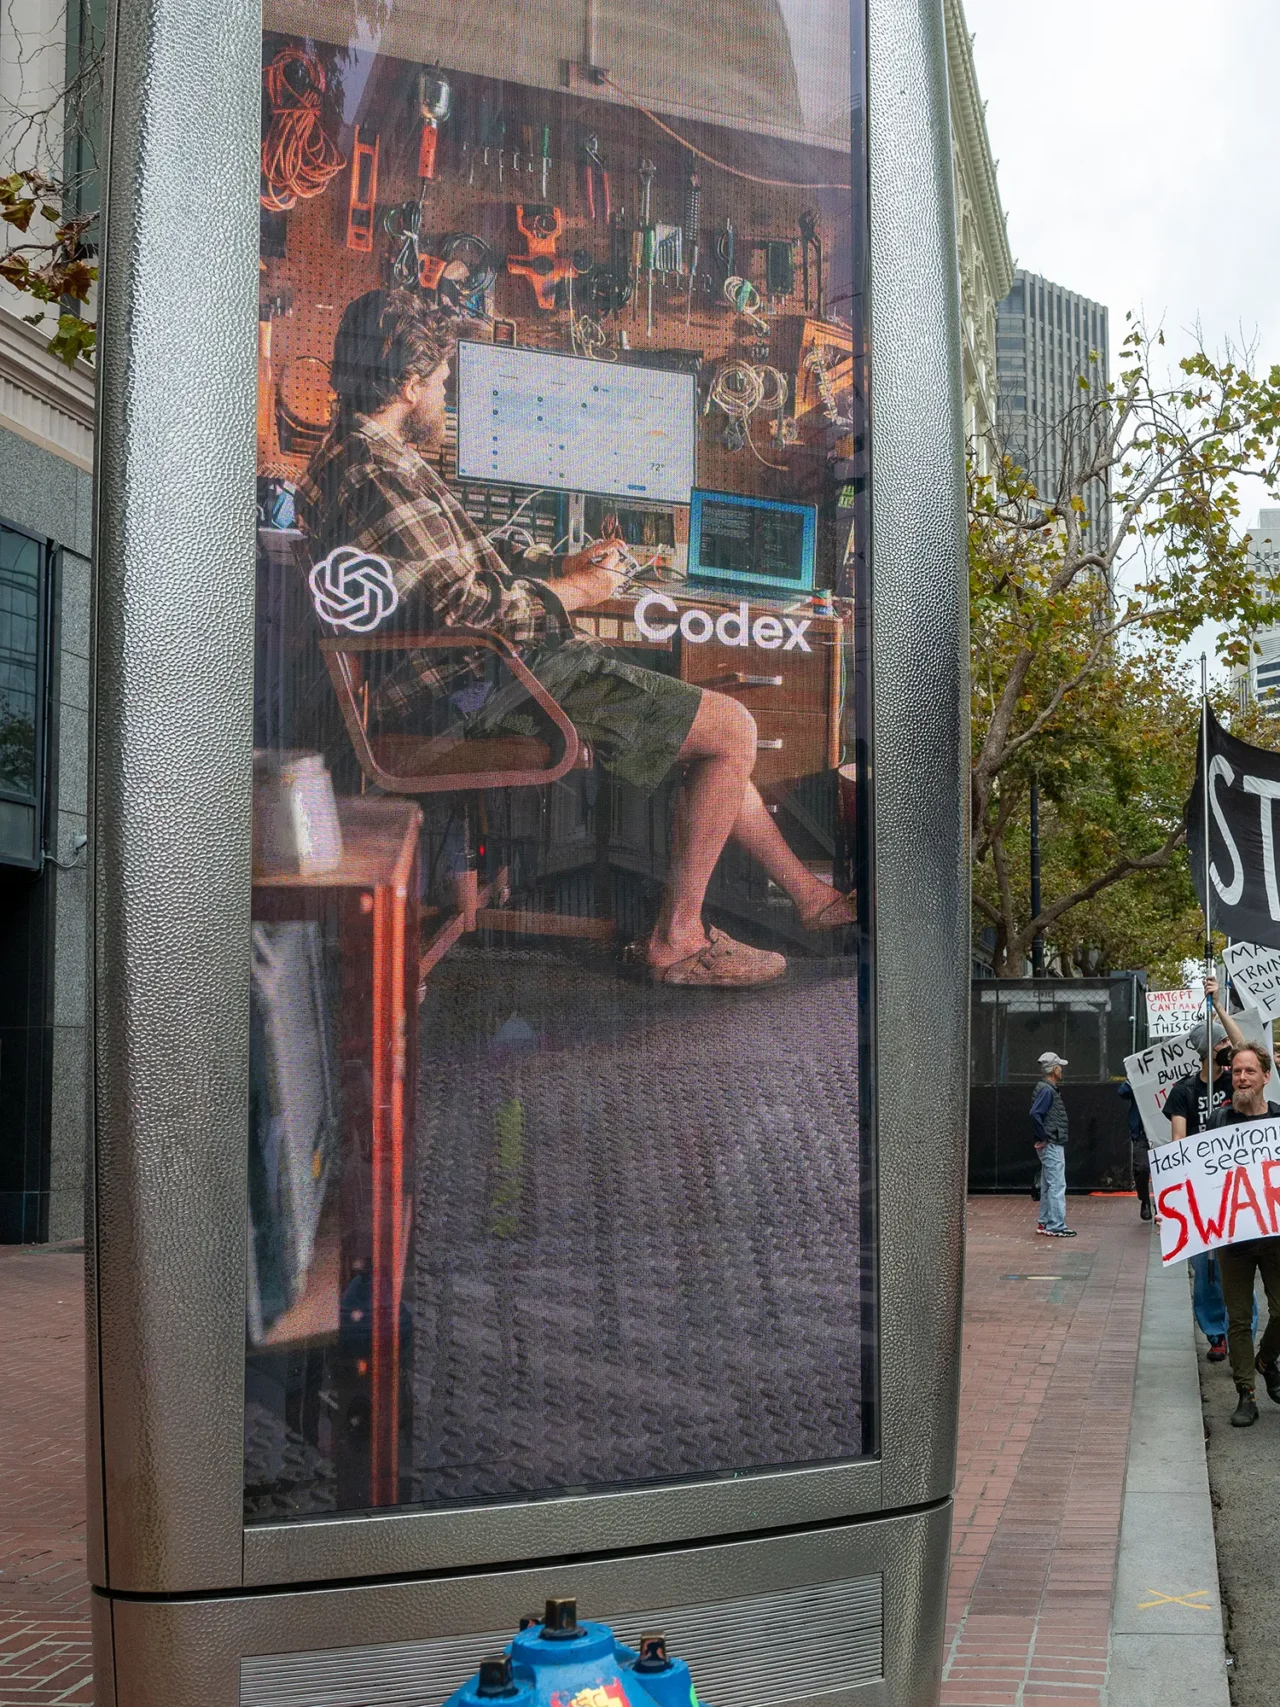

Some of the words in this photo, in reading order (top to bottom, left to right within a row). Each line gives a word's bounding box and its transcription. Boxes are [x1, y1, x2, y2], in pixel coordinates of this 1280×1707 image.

[634, 593, 812, 652] Codex
[1231, 944, 1267, 964] MA
[1147, 990, 1193, 1003] CHATGPT
[1153, 1023, 1181, 1035] THIS
[1182, 1023, 1195, 1032] GO
[1157, 1014, 1166, 1022] A
[1137, 1050, 1155, 1076] IF
[1160, 1043, 1184, 1067] NO
[1157, 1059, 1201, 1085] BUILDS
[1151, 1141, 1192, 1174] task
